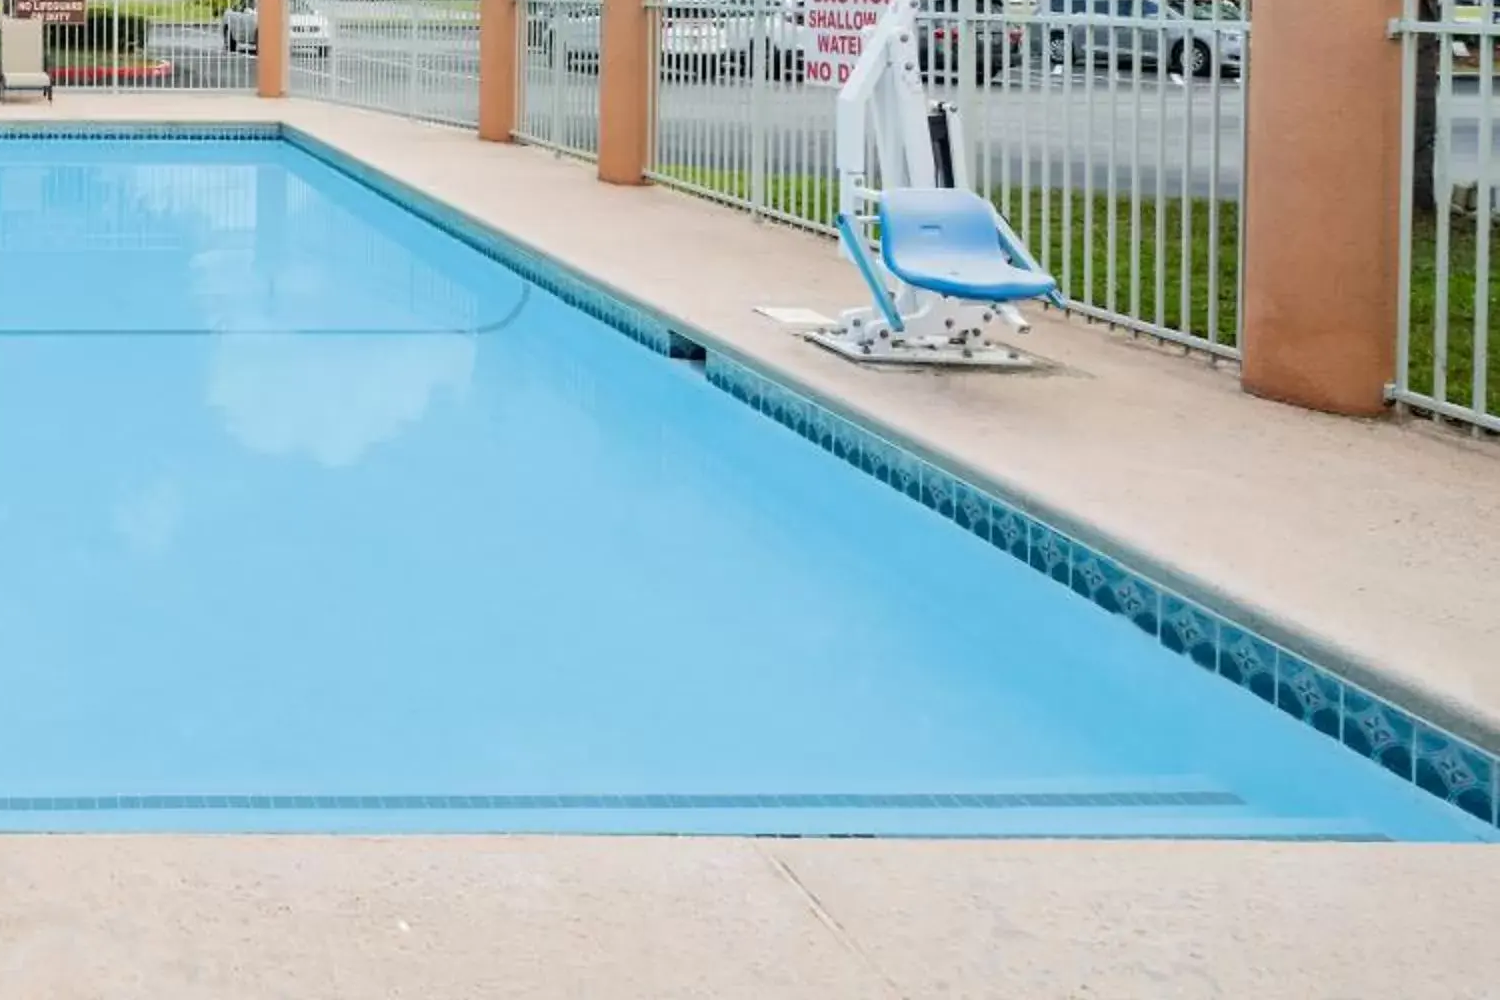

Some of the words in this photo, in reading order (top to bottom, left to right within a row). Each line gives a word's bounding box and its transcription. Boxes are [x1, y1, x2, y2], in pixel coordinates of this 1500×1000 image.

[18, 2, 33, 11] NO
[808, 10, 877, 30] SHALLOW
[807, 62, 832, 81] NO
